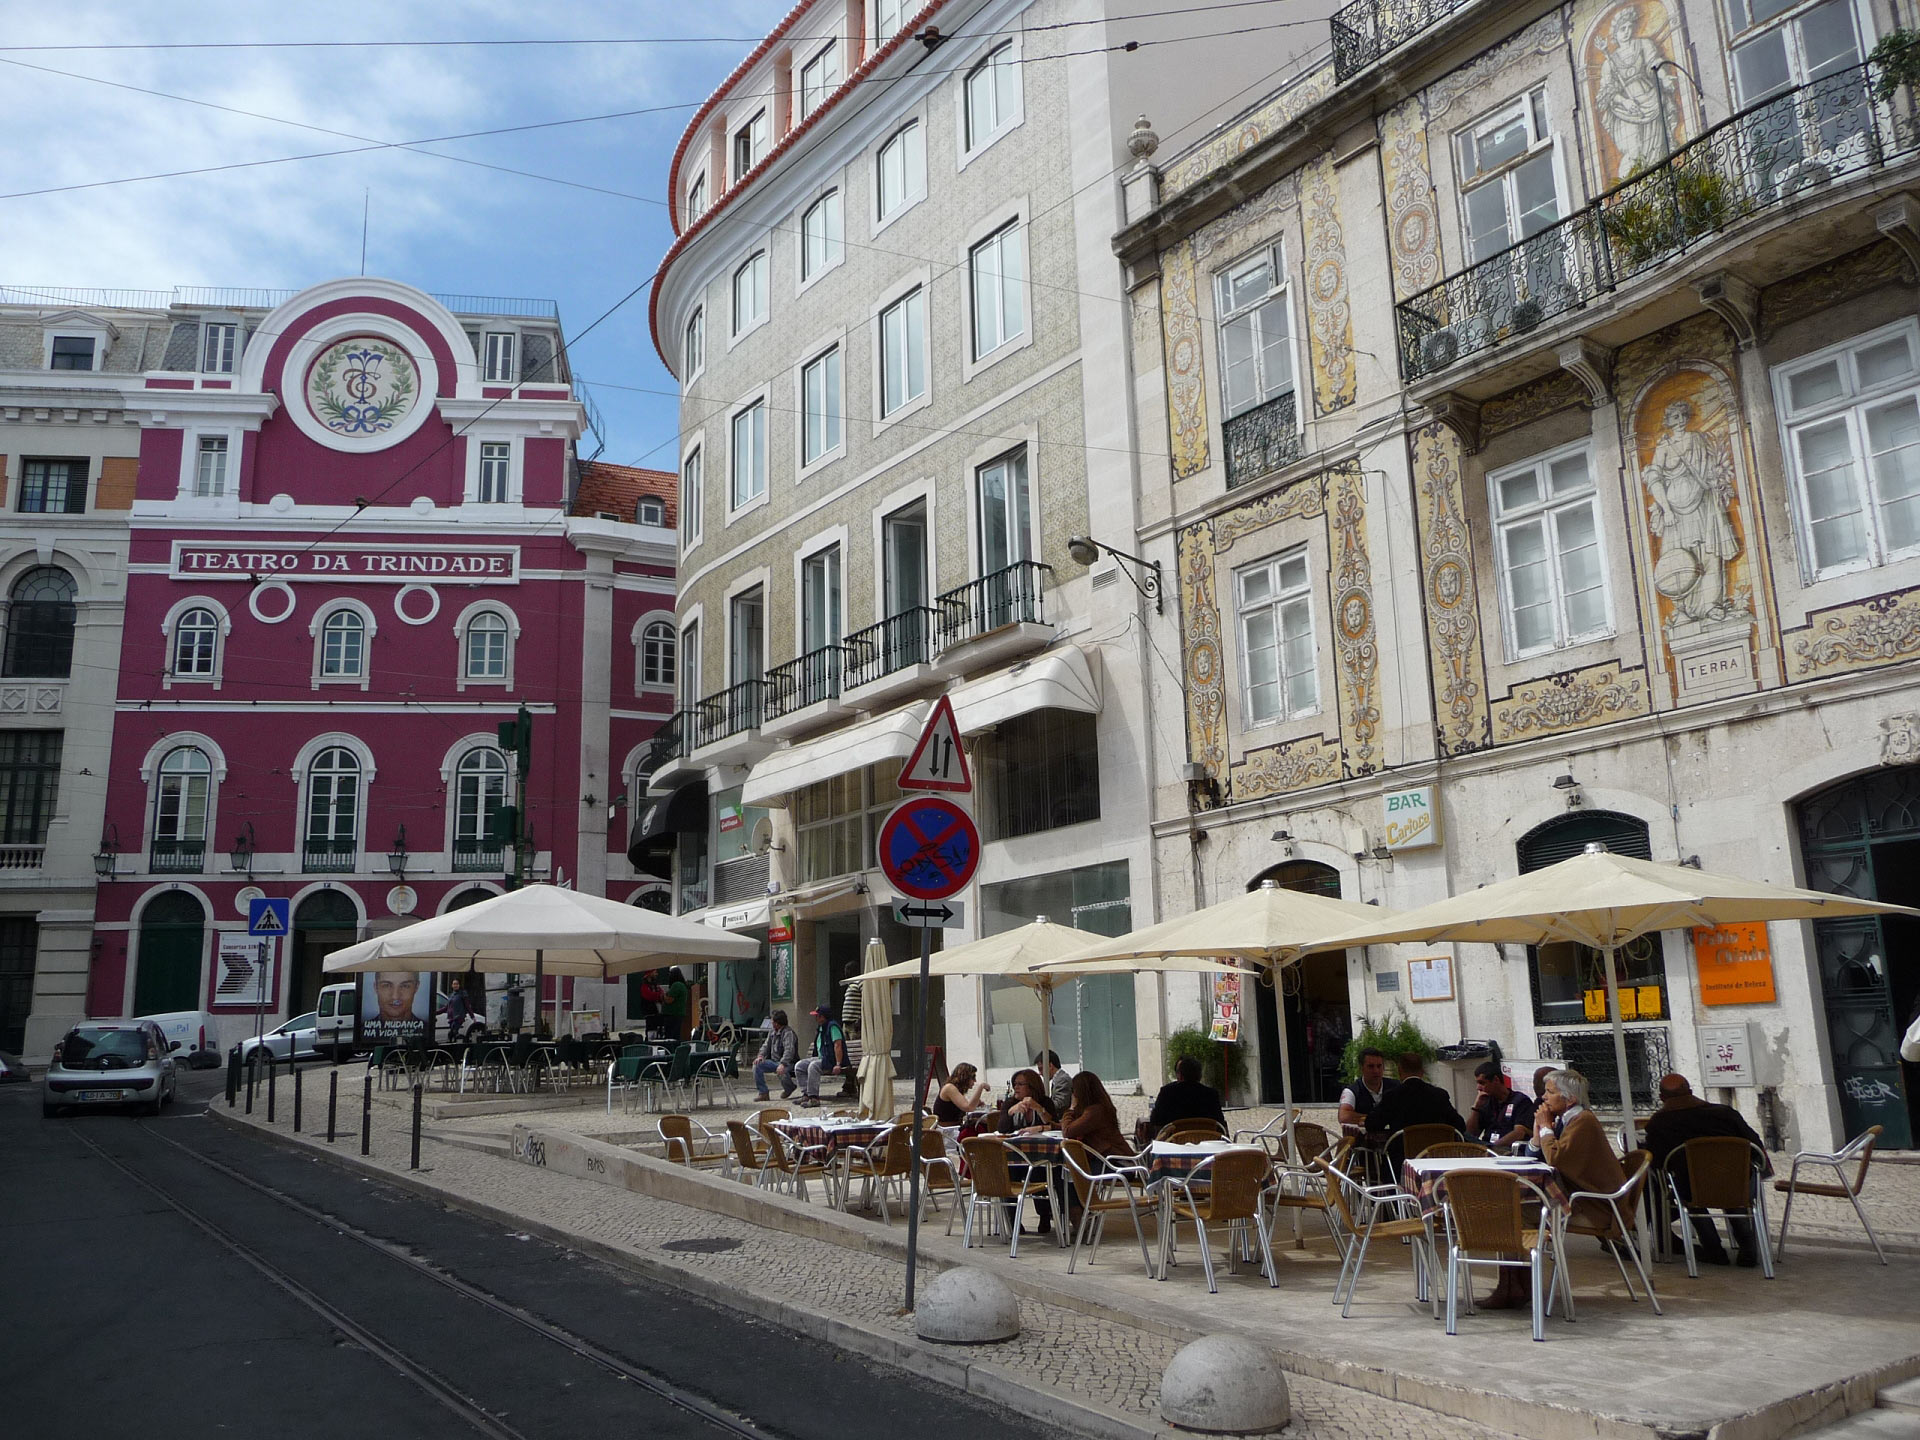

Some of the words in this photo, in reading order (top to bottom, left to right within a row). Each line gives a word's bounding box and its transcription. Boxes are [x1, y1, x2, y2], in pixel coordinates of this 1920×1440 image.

[185, 552, 299, 571] TEATRO
[311, 554, 351, 571] DA
[360, 555, 506, 573] TRINDADE
[1688, 658, 1738, 678] TERRA
[1387, 793, 1427, 812] BAR
[1386, 811, 1430, 845] Carioca
[363, 1028, 377, 1037] NA
[379, 1029, 399, 1038] VIDA
[364, 1020, 382, 1029] UMA
[384, 1020, 424, 1030] MUDANÇA
